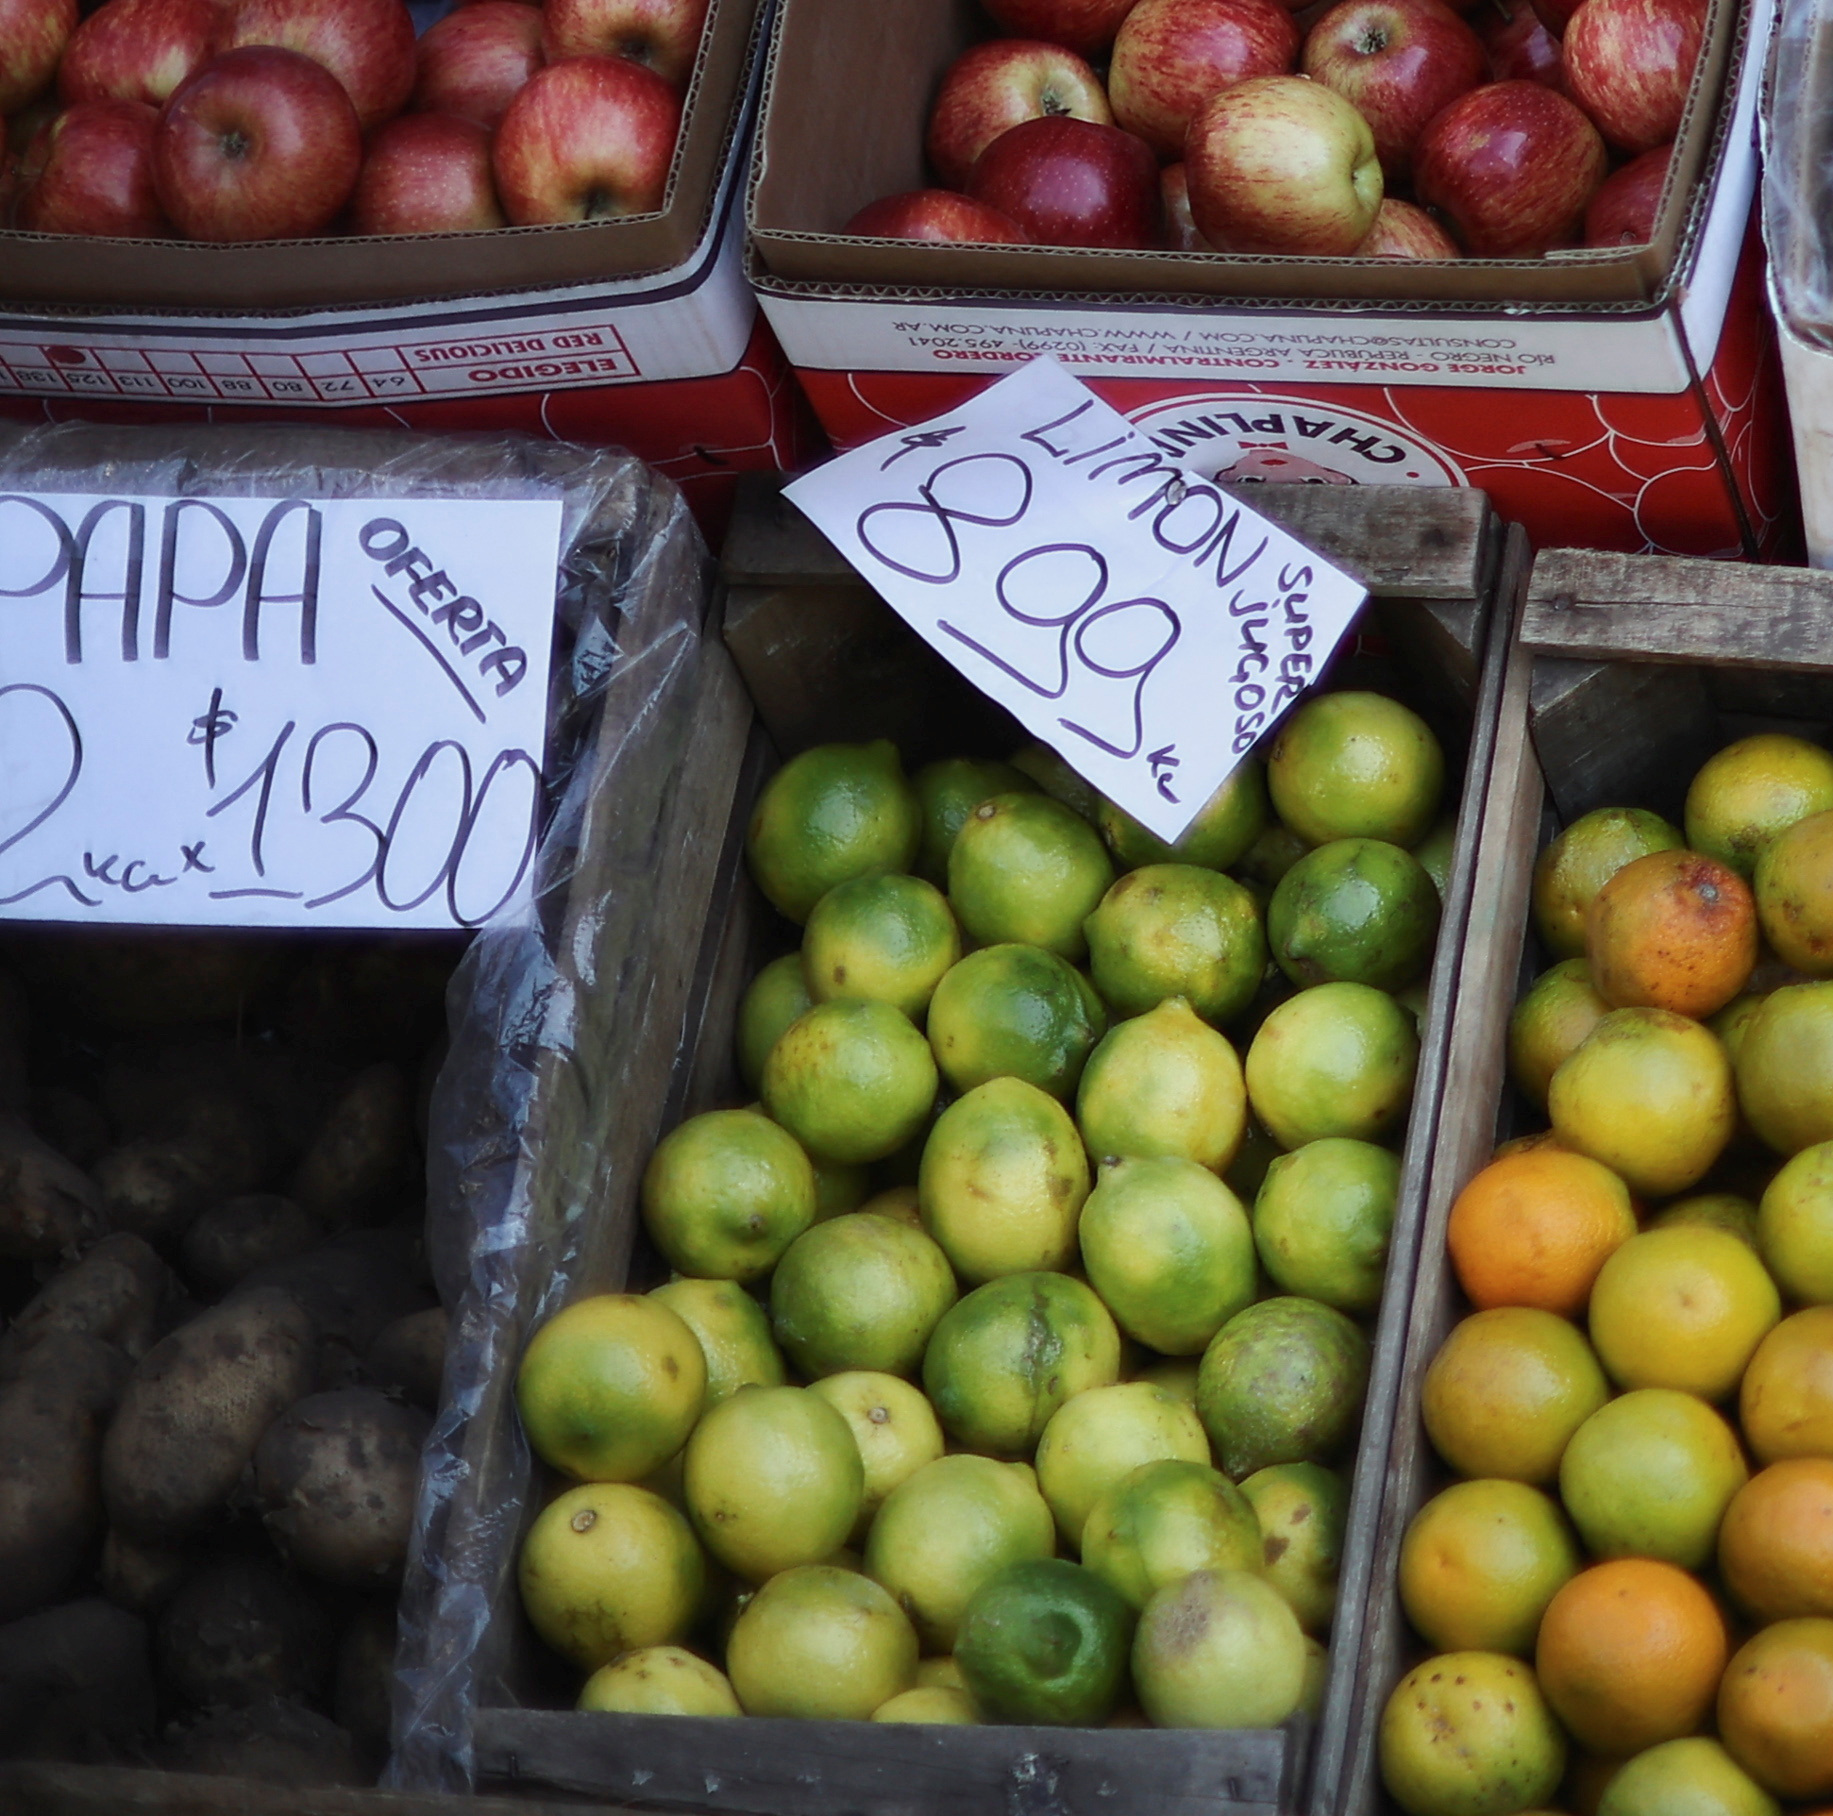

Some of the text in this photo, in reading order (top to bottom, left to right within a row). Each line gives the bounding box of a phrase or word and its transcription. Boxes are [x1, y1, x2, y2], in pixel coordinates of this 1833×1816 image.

[413, 331, 602, 365] RED DELICIOUS
[1162, 345, 1291, 359] ARGENTINA
[932, 348, 1526, 376] JORGE GONZÁLEZ CONTRALMIRANTE ORDERO
[1430, 351, 1512, 364] NEGRO
[467, 356, 617, 383] ELEGIDO
[66, 372, 106, 387] 125
[118, 374, 155, 390] 113
[166, 376, 205, 391] 100
[220, 379, 253, 394] 88
[322, 378, 354, 393] 72
[372, 374, 405, 388] 64
[271, 380, 303, 395] 80
[358, 517, 528, 698] OFERTA
[1270, 561, 1314, 716] SUPER
[187, 687, 543, 927] $1300
